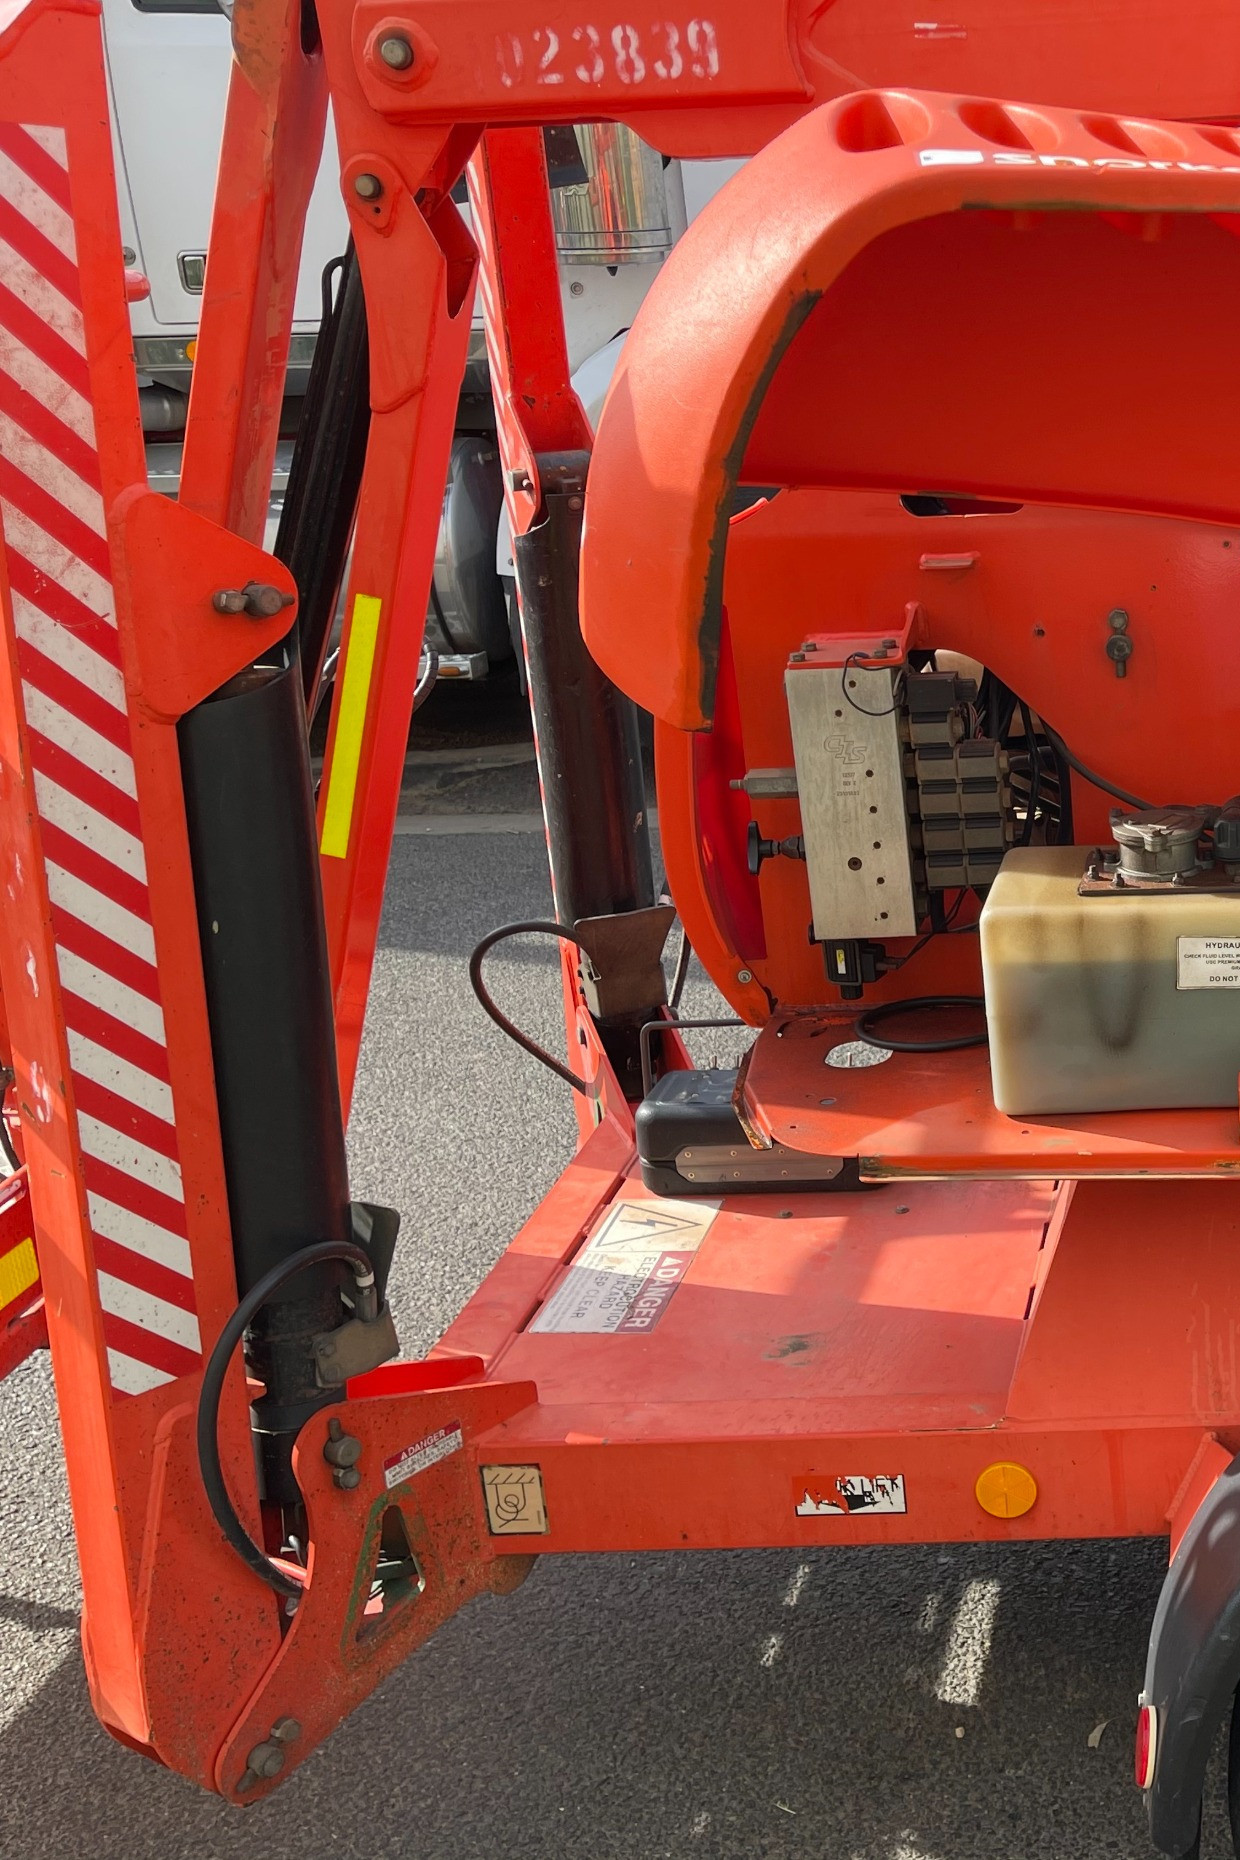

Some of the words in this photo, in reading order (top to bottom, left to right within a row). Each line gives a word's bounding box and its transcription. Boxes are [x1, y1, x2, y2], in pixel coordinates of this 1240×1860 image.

[595, 1265, 616, 1287] KEEP
[599, 1275, 629, 1309] HAZARD
[602, 1256, 657, 1328] ELECTROCUTION
[571, 1288, 600, 1319] CLEAR
[624, 1268, 680, 1328] DANGER
[407, 1429, 446, 1457] DANGER
